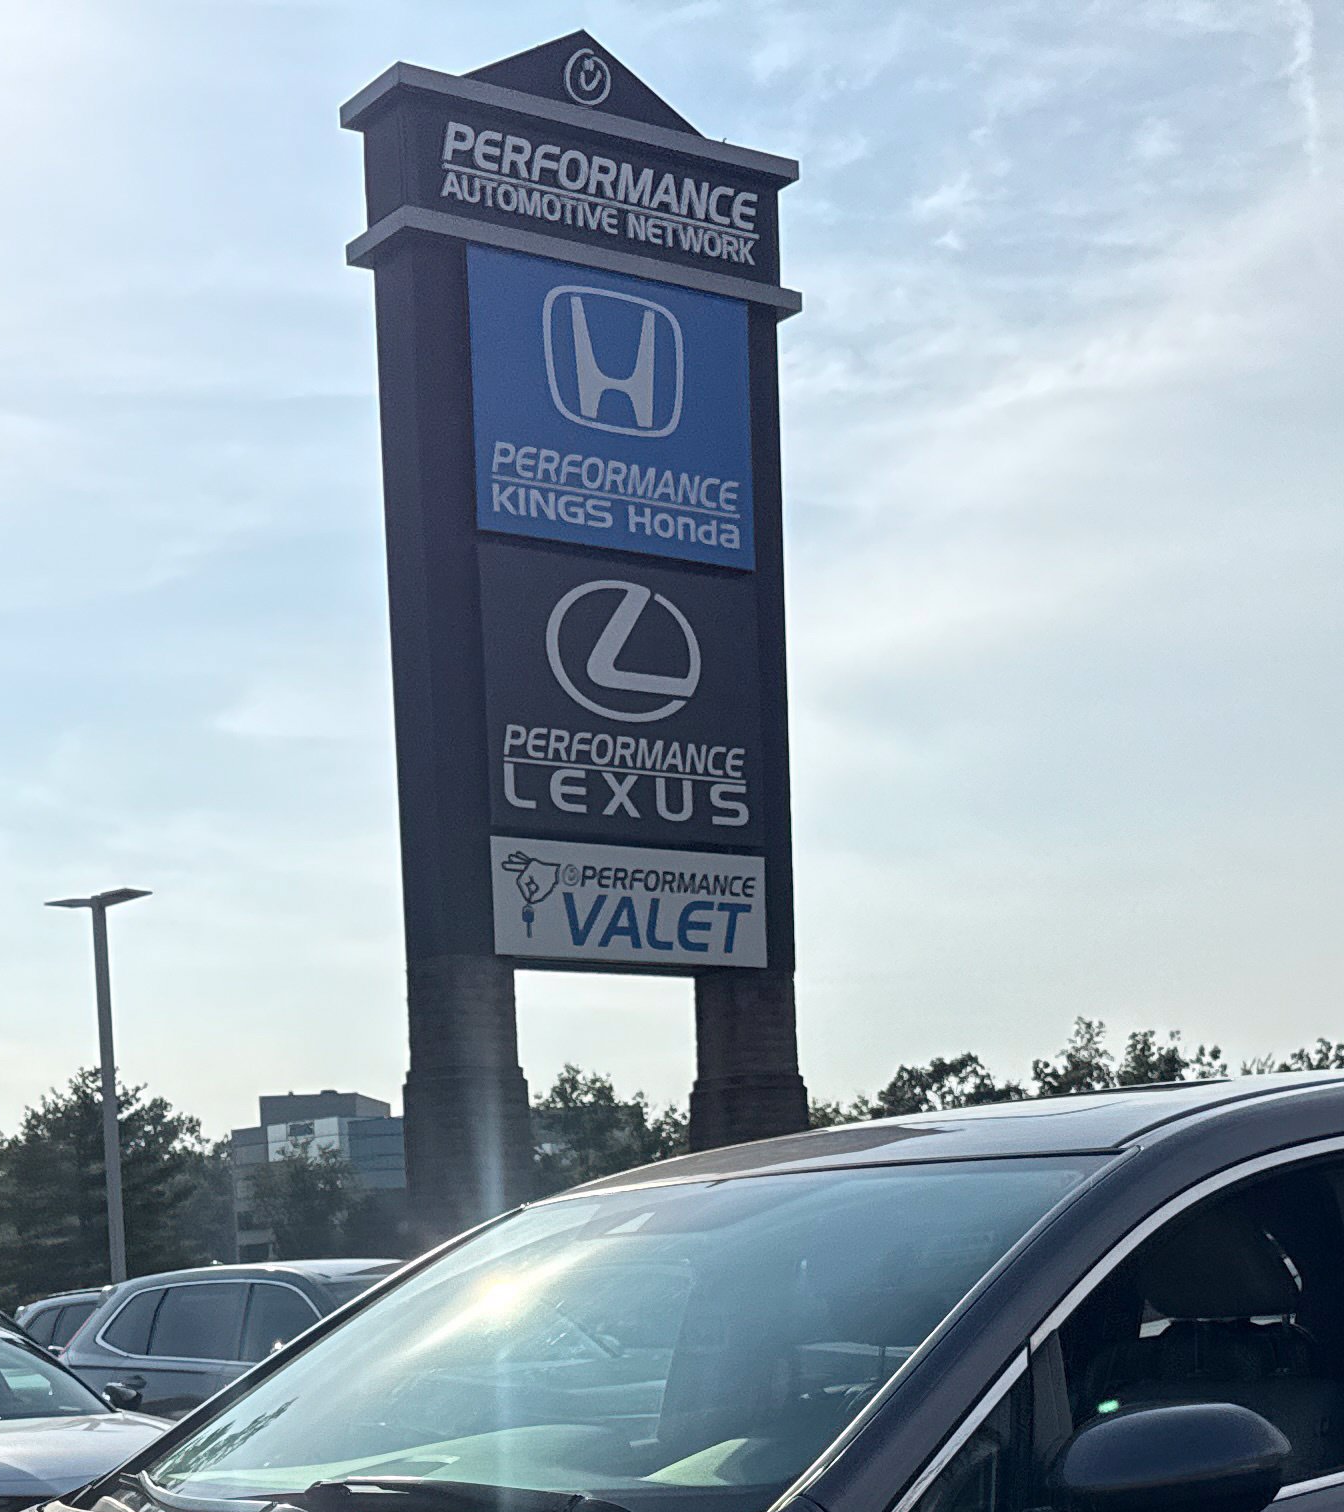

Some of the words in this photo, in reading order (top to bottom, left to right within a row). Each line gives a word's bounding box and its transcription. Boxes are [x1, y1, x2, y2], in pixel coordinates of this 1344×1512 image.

[442, 121, 758, 231] PERFORMANCE
[441, 171, 619, 236] AUTOMOTIVE
[627, 212, 756, 265] NETWORK
[491, 440, 740, 511] PERFORMANCE
[491, 482, 613, 529] KINGS
[627, 503, 741, 550] Honda
[503, 723, 746, 778] PERFORMANCE
[503, 762, 750, 827] LEXUS
[580, 865, 755, 898] PERFORMANCE
[561, 891, 752, 955] VALET
